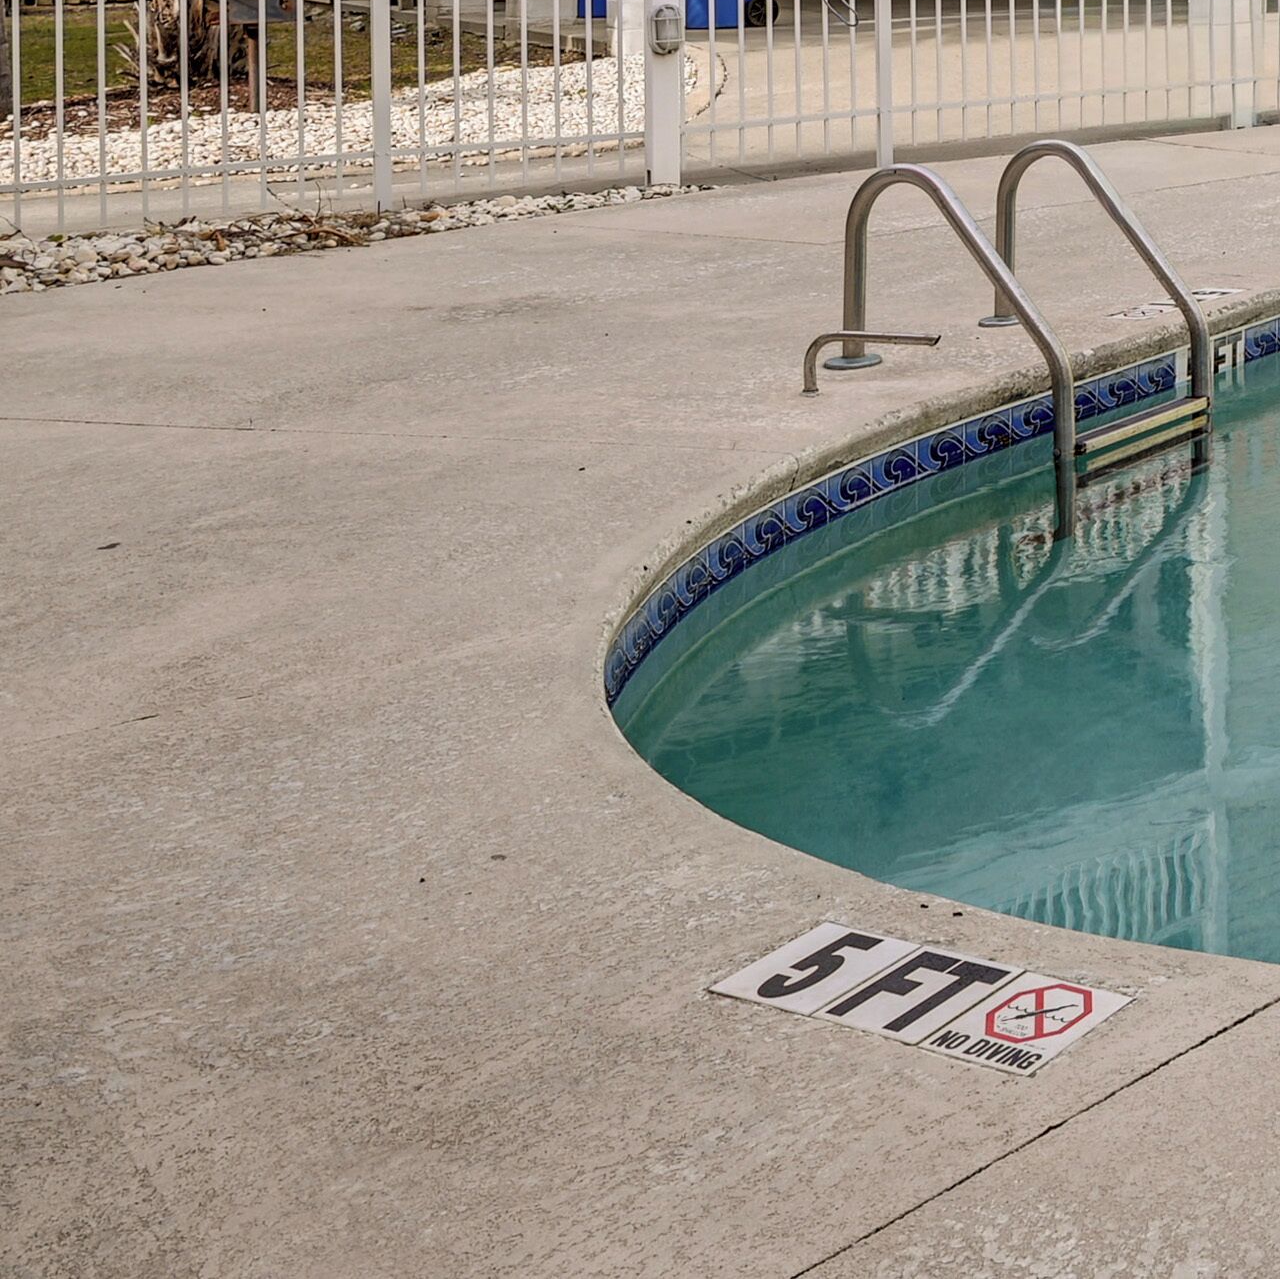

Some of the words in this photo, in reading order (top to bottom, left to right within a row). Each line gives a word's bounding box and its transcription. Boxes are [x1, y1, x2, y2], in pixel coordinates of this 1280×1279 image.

[757, 931, 885, 999] 5
[828, 950, 1012, 1033] FT
[931, 1029, 968, 1052] NO
[962, 1038, 1045, 1071] DIVING
